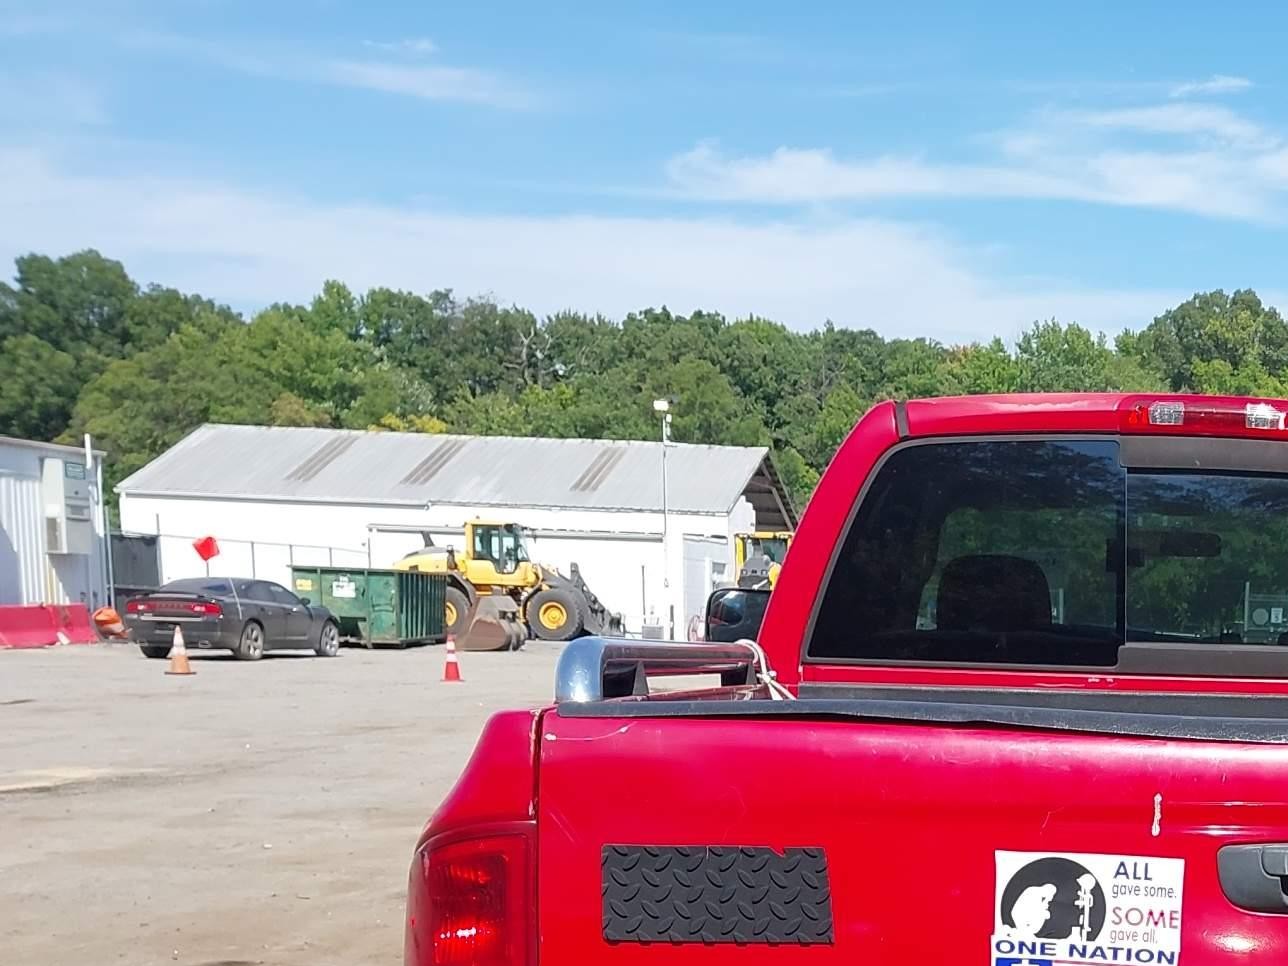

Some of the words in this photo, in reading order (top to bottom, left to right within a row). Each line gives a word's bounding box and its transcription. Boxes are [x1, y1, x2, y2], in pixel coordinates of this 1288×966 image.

[1113, 861, 1153, 881] ALL
[1111, 883, 1141, 898] gave
[1111, 906, 1179, 929] SOME
[1110, 930, 1138, 944] gave
[995, 939, 1057, 956] ONE
[1068, 943, 1175, 965] NATION
